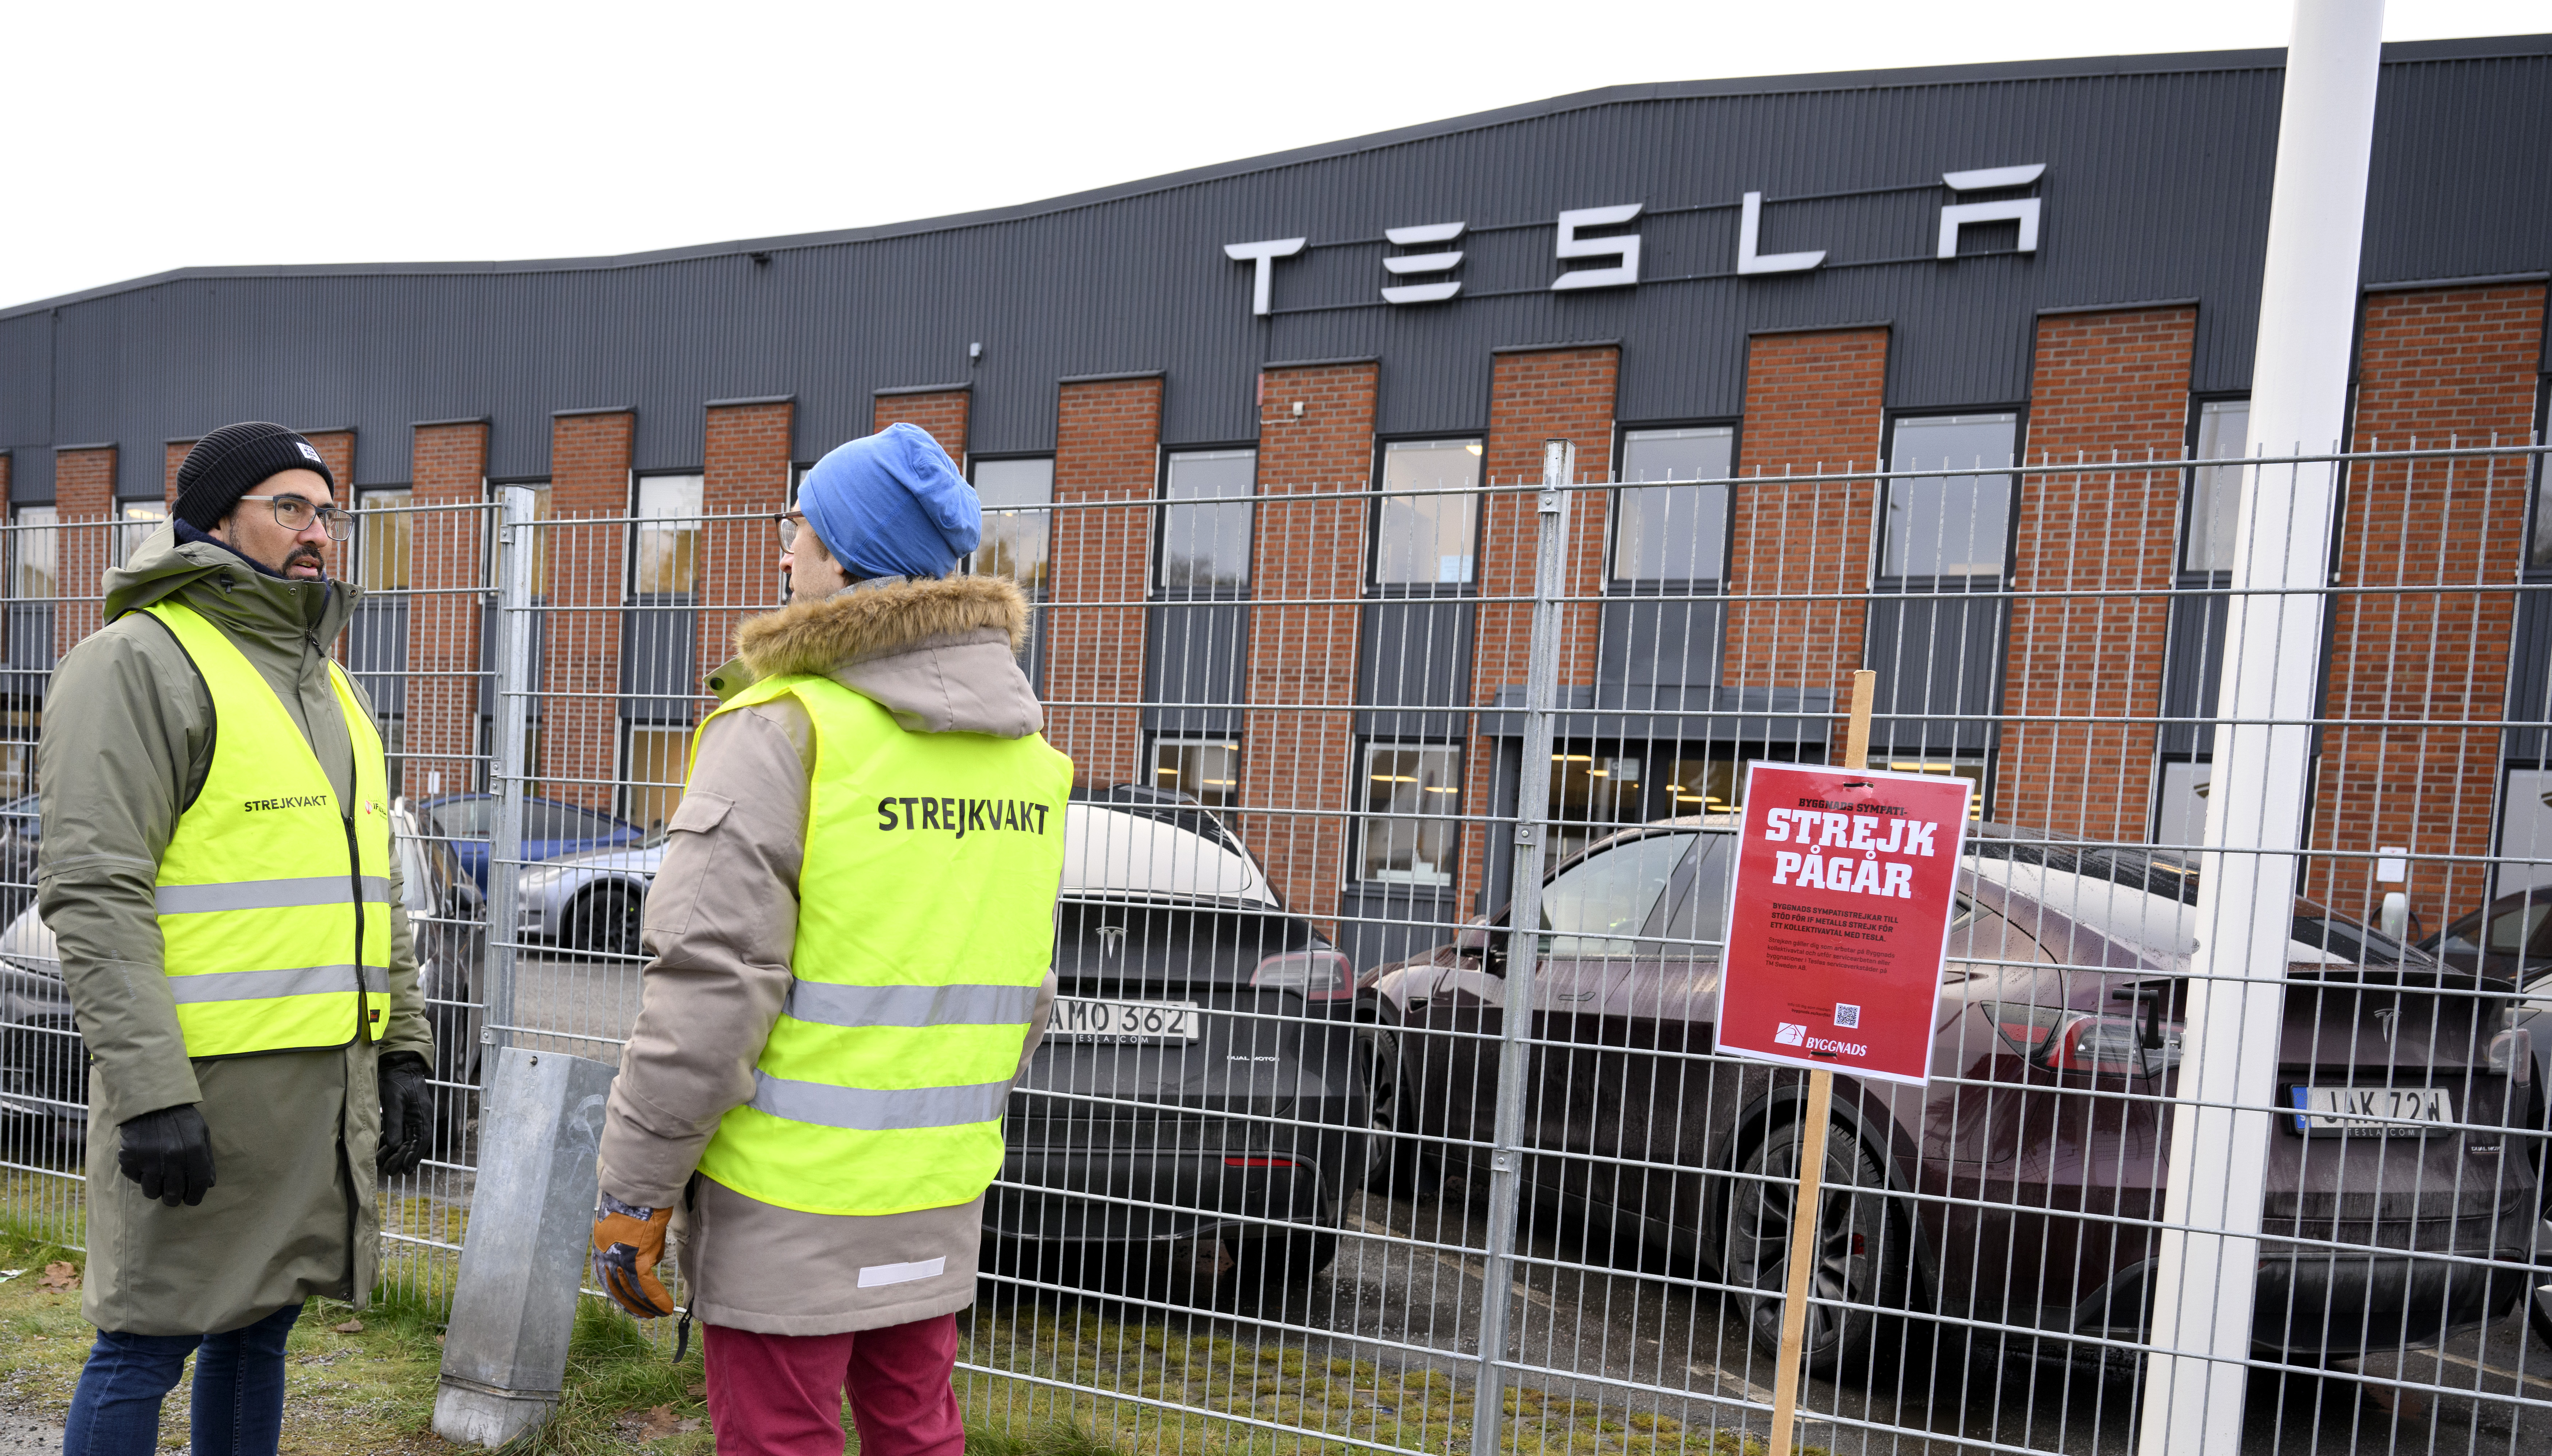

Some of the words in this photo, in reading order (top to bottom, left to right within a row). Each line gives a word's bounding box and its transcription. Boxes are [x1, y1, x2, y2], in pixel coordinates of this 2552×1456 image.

[1224, 163, 2046, 315] TESLA
[244, 795, 327, 812] STREJKVAKT
[1798, 798, 1854, 811] BYGGNADS
[1856, 803, 1908, 816] SYMPATI-
[878, 797, 1049, 839] STREJKVAKT
[1765, 807, 1938, 857] STREJK
[1772, 844, 1913, 899] PÅGÅR
[1771, 911, 1790, 920] STÖD
[1792, 914, 1806, 922] FÖR
[1815, 917, 1847, 927] METALLS
[1848, 921, 1877, 931] STREJK
[1878, 924, 1893, 932] FÖR
[1772, 902, 1811, 913] BYGGNADS
[1813, 907, 1882, 922] SYMPATISTREJKAR
[1784, 923, 1843, 937] KOLLEKTIVAVTAL
[1862, 933, 1886, 942] TESLA.
[1766, 952, 1804, 963] byggnationer
[1826, 961, 1879, 972] serviceverkstäder
[1767, 944, 1805, 954] kollektivavtal
[1833, 954, 1876, 964] servicearbeten
[1865, 950, 1895, 958] Byggnads
[123, 975, 137, 1000] NORWAY
[1122, 1003, 1184, 1033] 362
[1791, 1008, 1831, 1017] byggnads.se/konflikt
[1806, 1037, 1868, 1056] BYGGNADS
